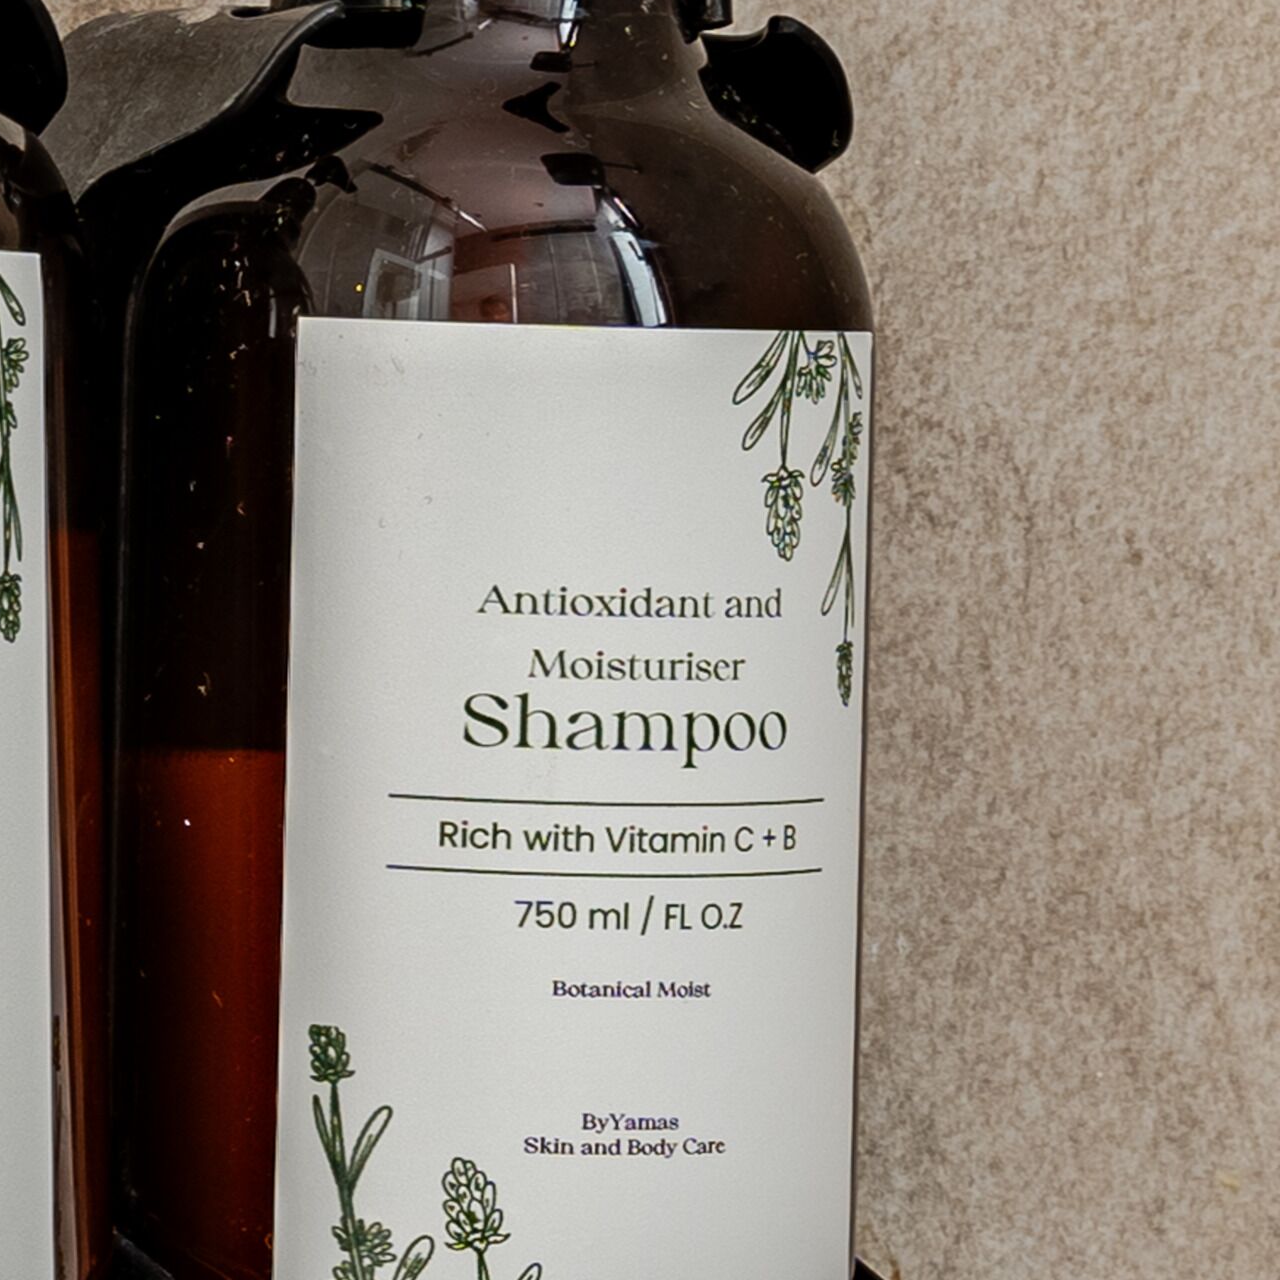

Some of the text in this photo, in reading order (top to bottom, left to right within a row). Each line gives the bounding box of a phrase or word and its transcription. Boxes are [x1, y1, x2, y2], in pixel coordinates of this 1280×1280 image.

[476, 584, 782, 619] Antioxidant and
[527, 648, 747, 682] Moisturiser
[463, 692, 788, 769] Shampoo
[438, 819, 512, 851] Rich
[522, 823, 595, 853] with
[604, 824, 726, 854] Vitamin
[733, 825, 755, 853] C
[783, 824, 797, 851] B
[514, 900, 578, 930] 750
[588, 901, 630, 931] ml
[664, 903, 693, 931] FL
[552, 979, 712, 999] Botanical Moist
[523, 1136, 726, 1159] Skin and Body Care
